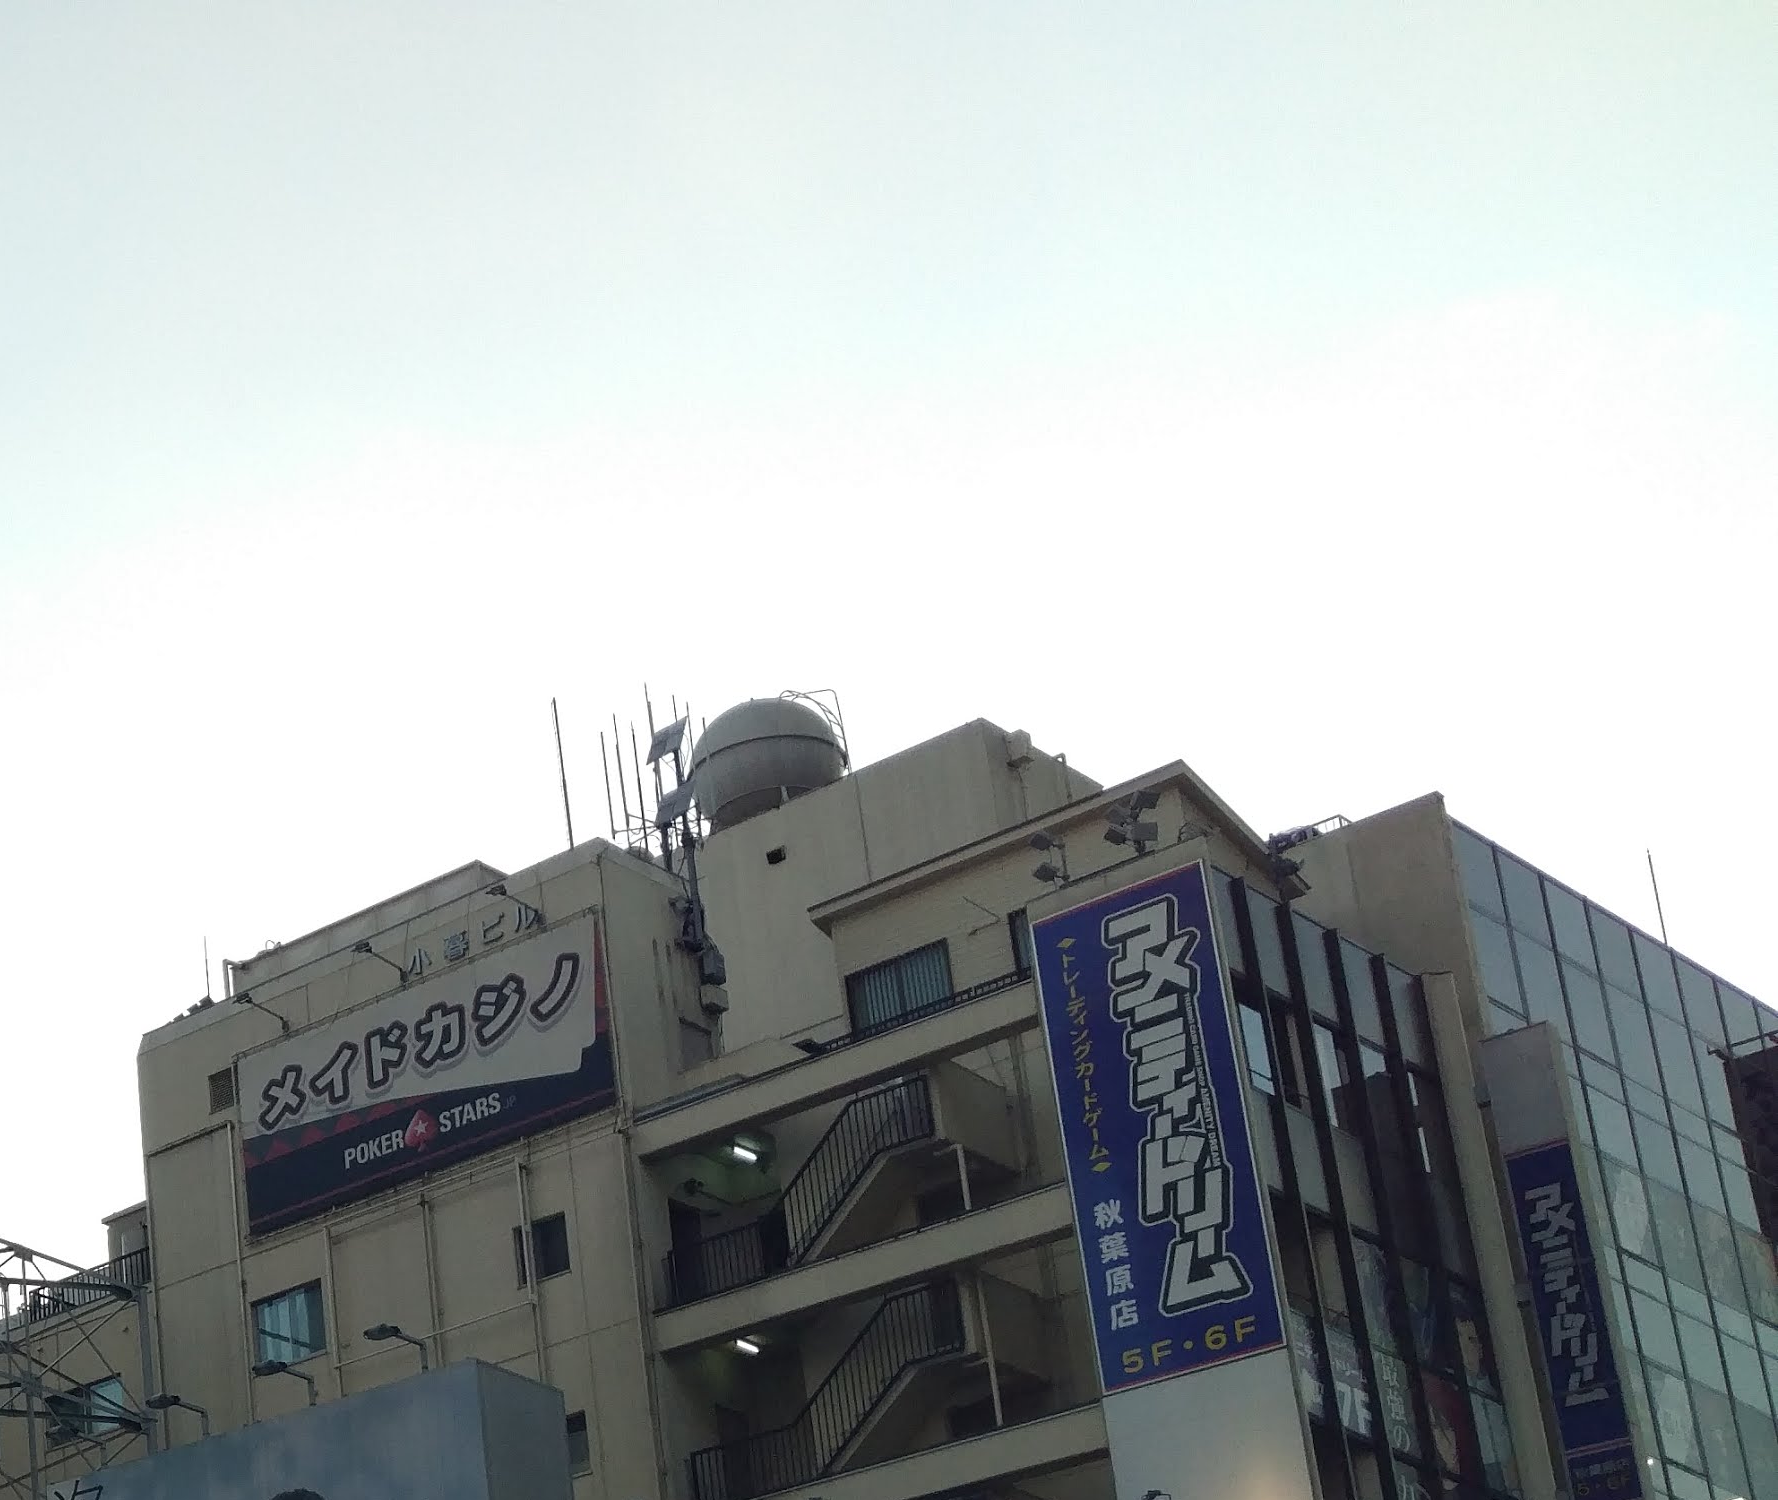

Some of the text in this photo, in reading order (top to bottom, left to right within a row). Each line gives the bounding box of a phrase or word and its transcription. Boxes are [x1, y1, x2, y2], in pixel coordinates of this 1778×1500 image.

[257, 952, 581, 1131] メイドカジノ
[1059, 953, 1110, 1161] トレーディングカードゲーム
[343, 1128, 405, 1171] POKER
[1093, 1200, 1139, 1332] 秋葉原店
